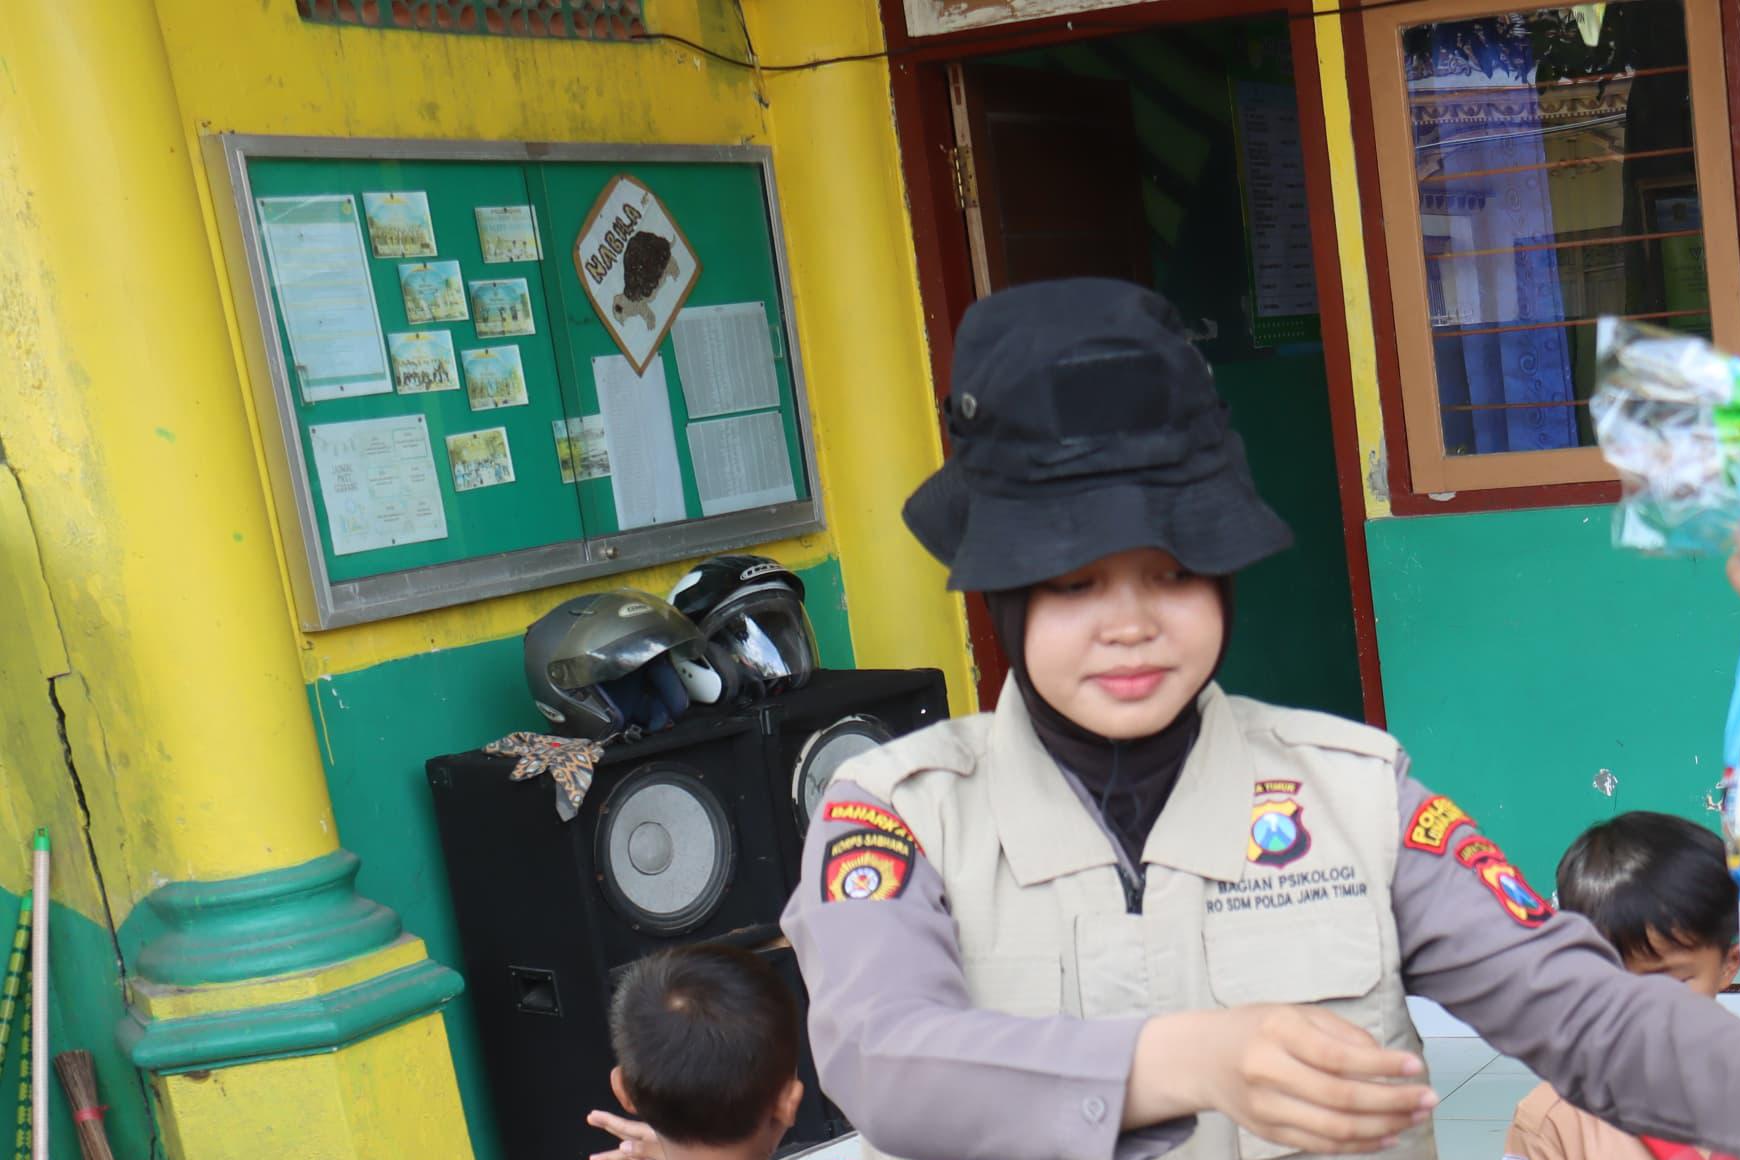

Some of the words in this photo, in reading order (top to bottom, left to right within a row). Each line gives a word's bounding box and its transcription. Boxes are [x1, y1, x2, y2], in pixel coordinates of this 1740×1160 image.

[1217, 876, 1273, 894] BAGIAN
[1279, 866, 1355, 888] PSIKOLOGI
[1206, 900, 1223, 914] RO
[1226, 896, 1251, 912] SDM
[1255, 893, 1293, 910] POLDA
[1297, 885, 1329, 904] JAWA
[1332, 883, 1367, 899] TIMUR
